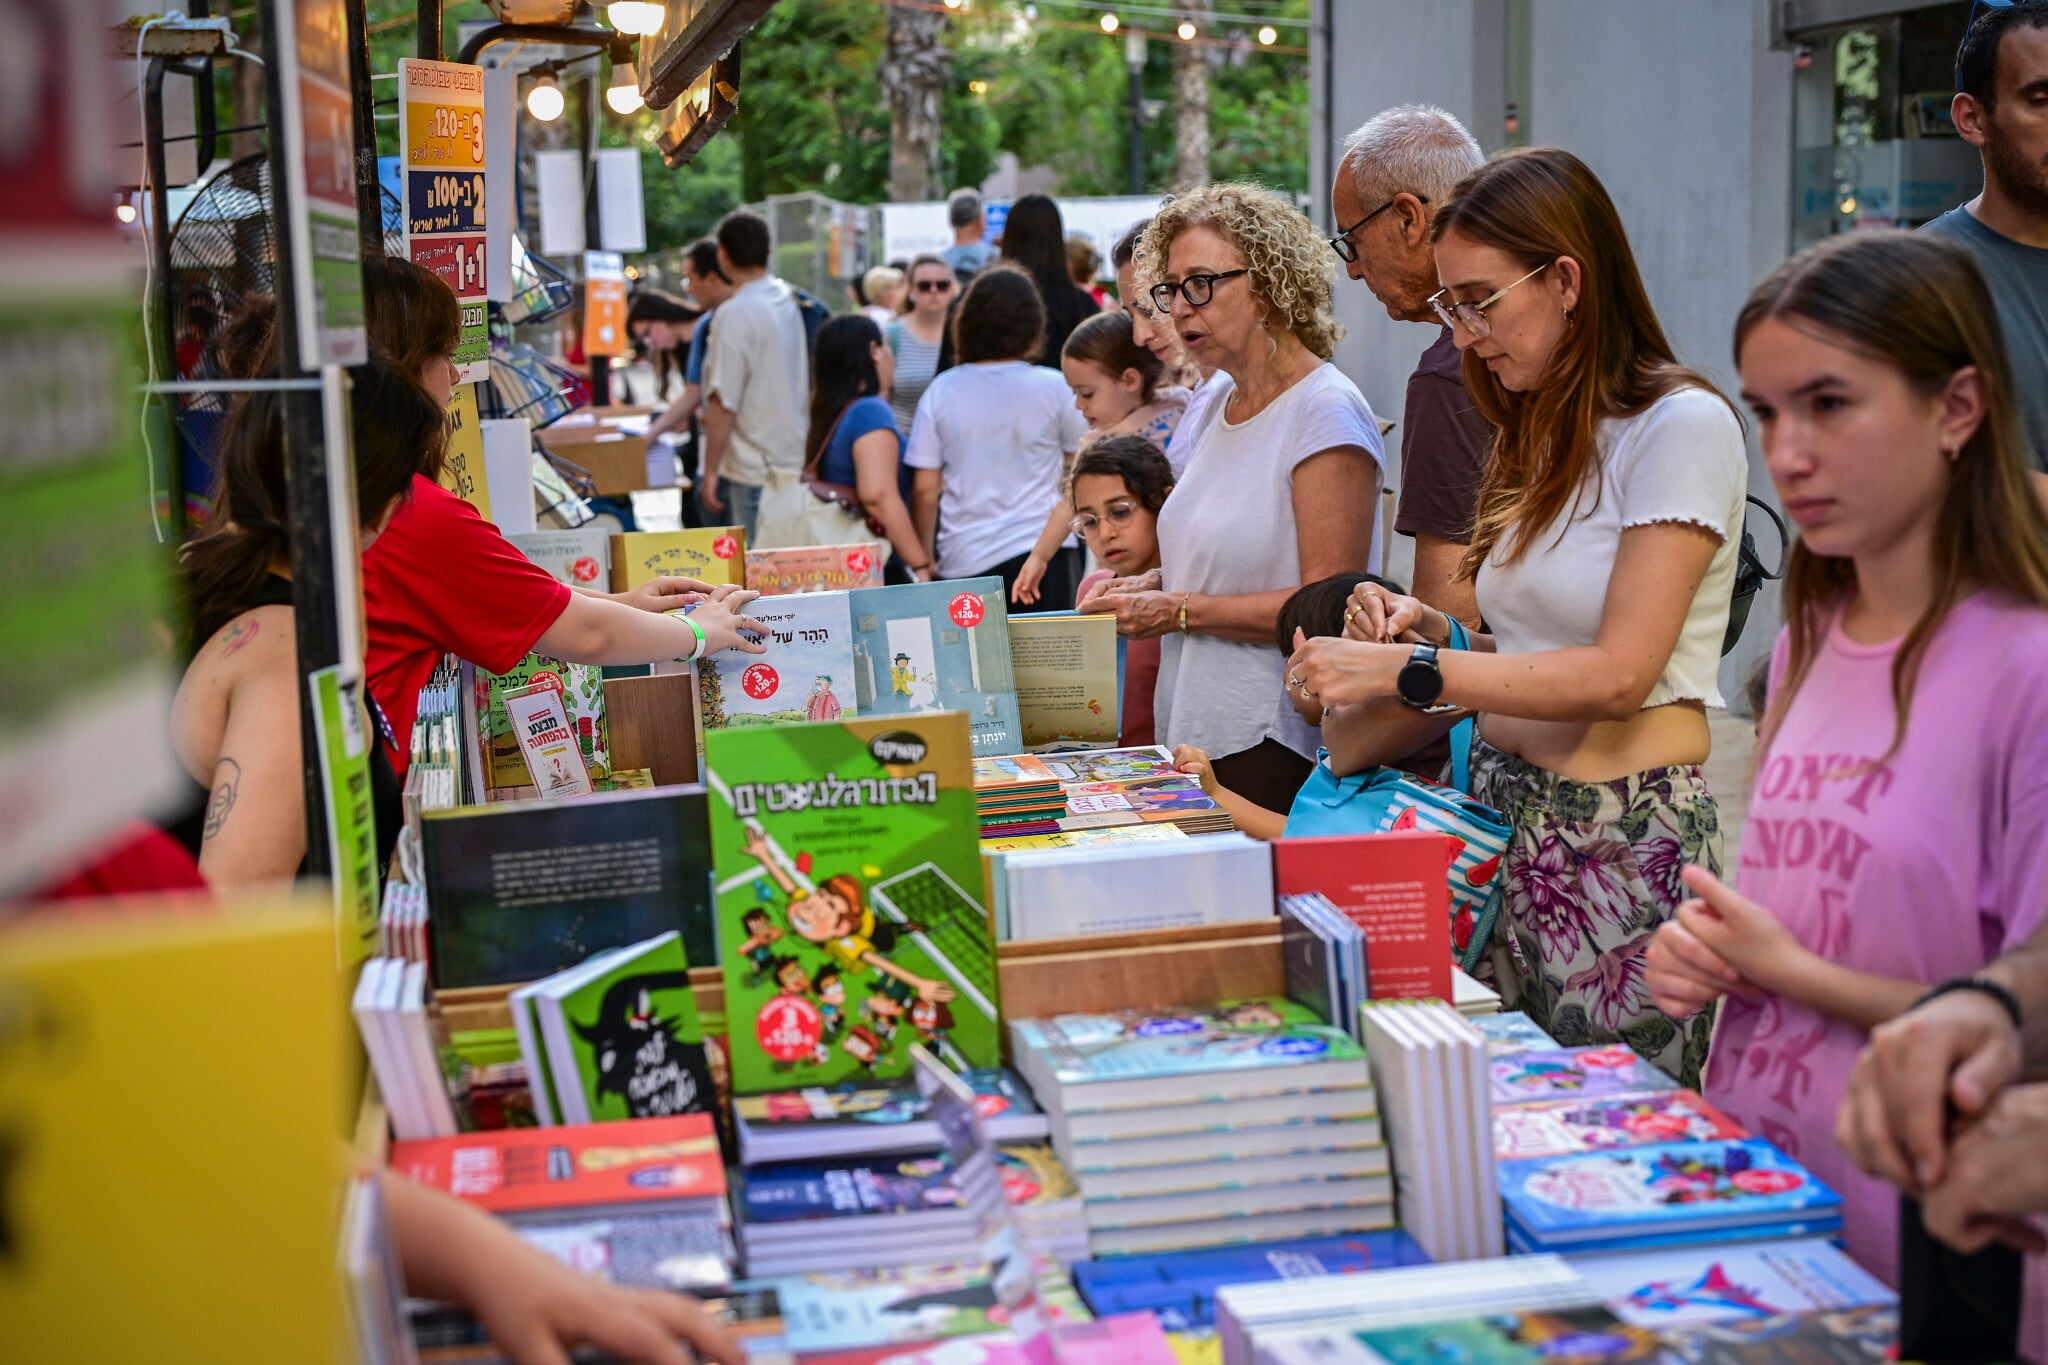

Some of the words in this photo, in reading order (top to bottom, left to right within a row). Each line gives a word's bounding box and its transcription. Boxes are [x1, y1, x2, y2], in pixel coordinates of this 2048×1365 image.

[471, 111, 485, 163] 3
[433, 175, 472, 207] ב-100
[472, 174, 485, 225] 2
[455, 242, 485, 291] 1+1
[962, 599, 971, 610] 3
[752, 671, 764, 683] 3
[527, 727, 570, 750] בהפתעה
[528, 716, 558, 736] מבצע
[1761, 754, 1894, 815] ON'T
[1742, 818, 1874, 882] NOW
